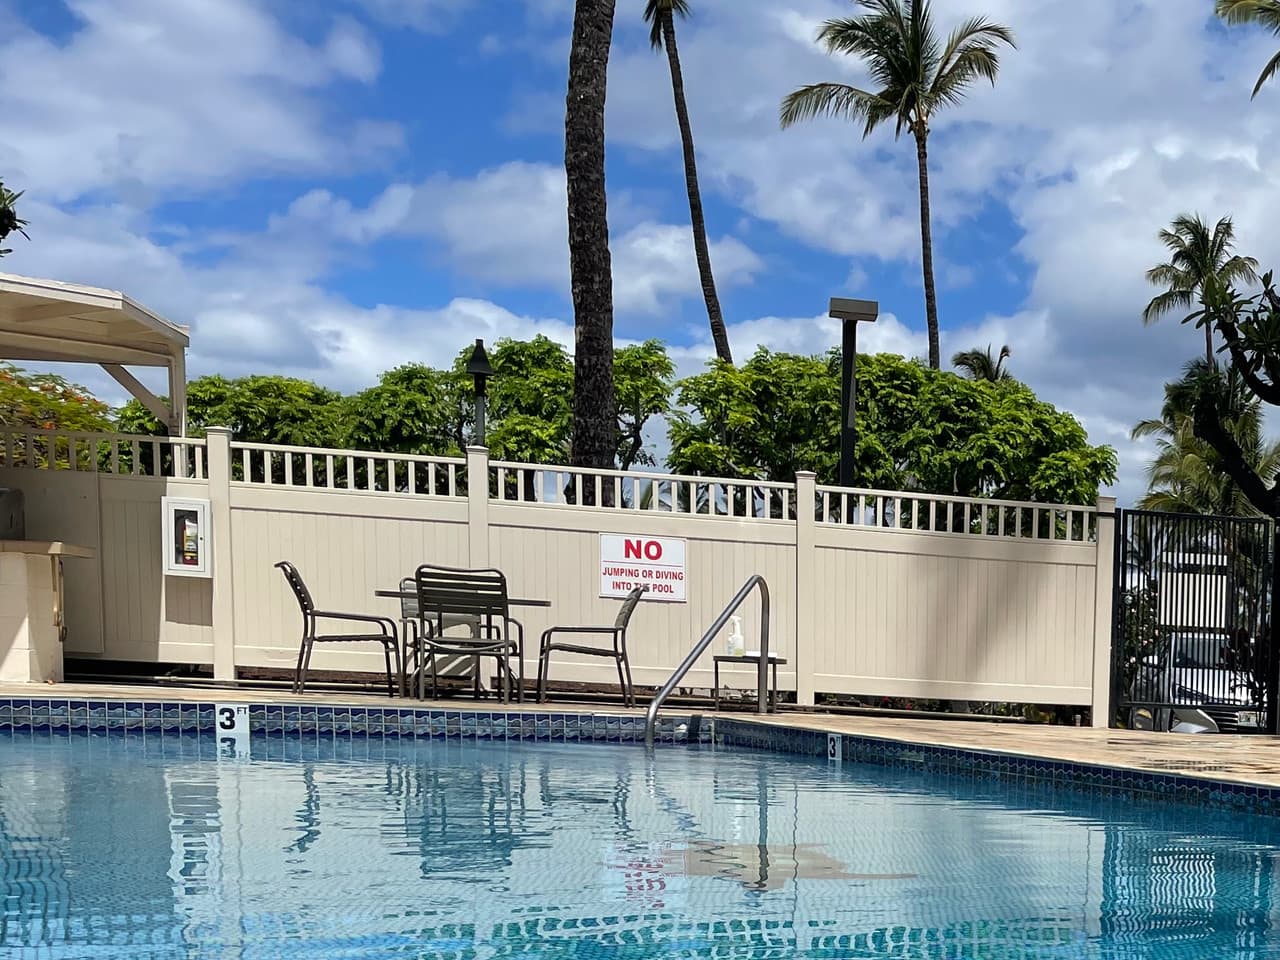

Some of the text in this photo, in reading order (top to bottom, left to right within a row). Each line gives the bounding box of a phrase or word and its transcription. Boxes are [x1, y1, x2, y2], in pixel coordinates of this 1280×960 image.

[624, 538, 663, 561] NO
[602, 567, 684, 581] JUMPING OR DIVING
[612, 581, 632, 591] INTO
[652, 583, 675, 594] POOL
[219, 706, 248, 730] 3 FT
[829, 736, 836, 758] 3
